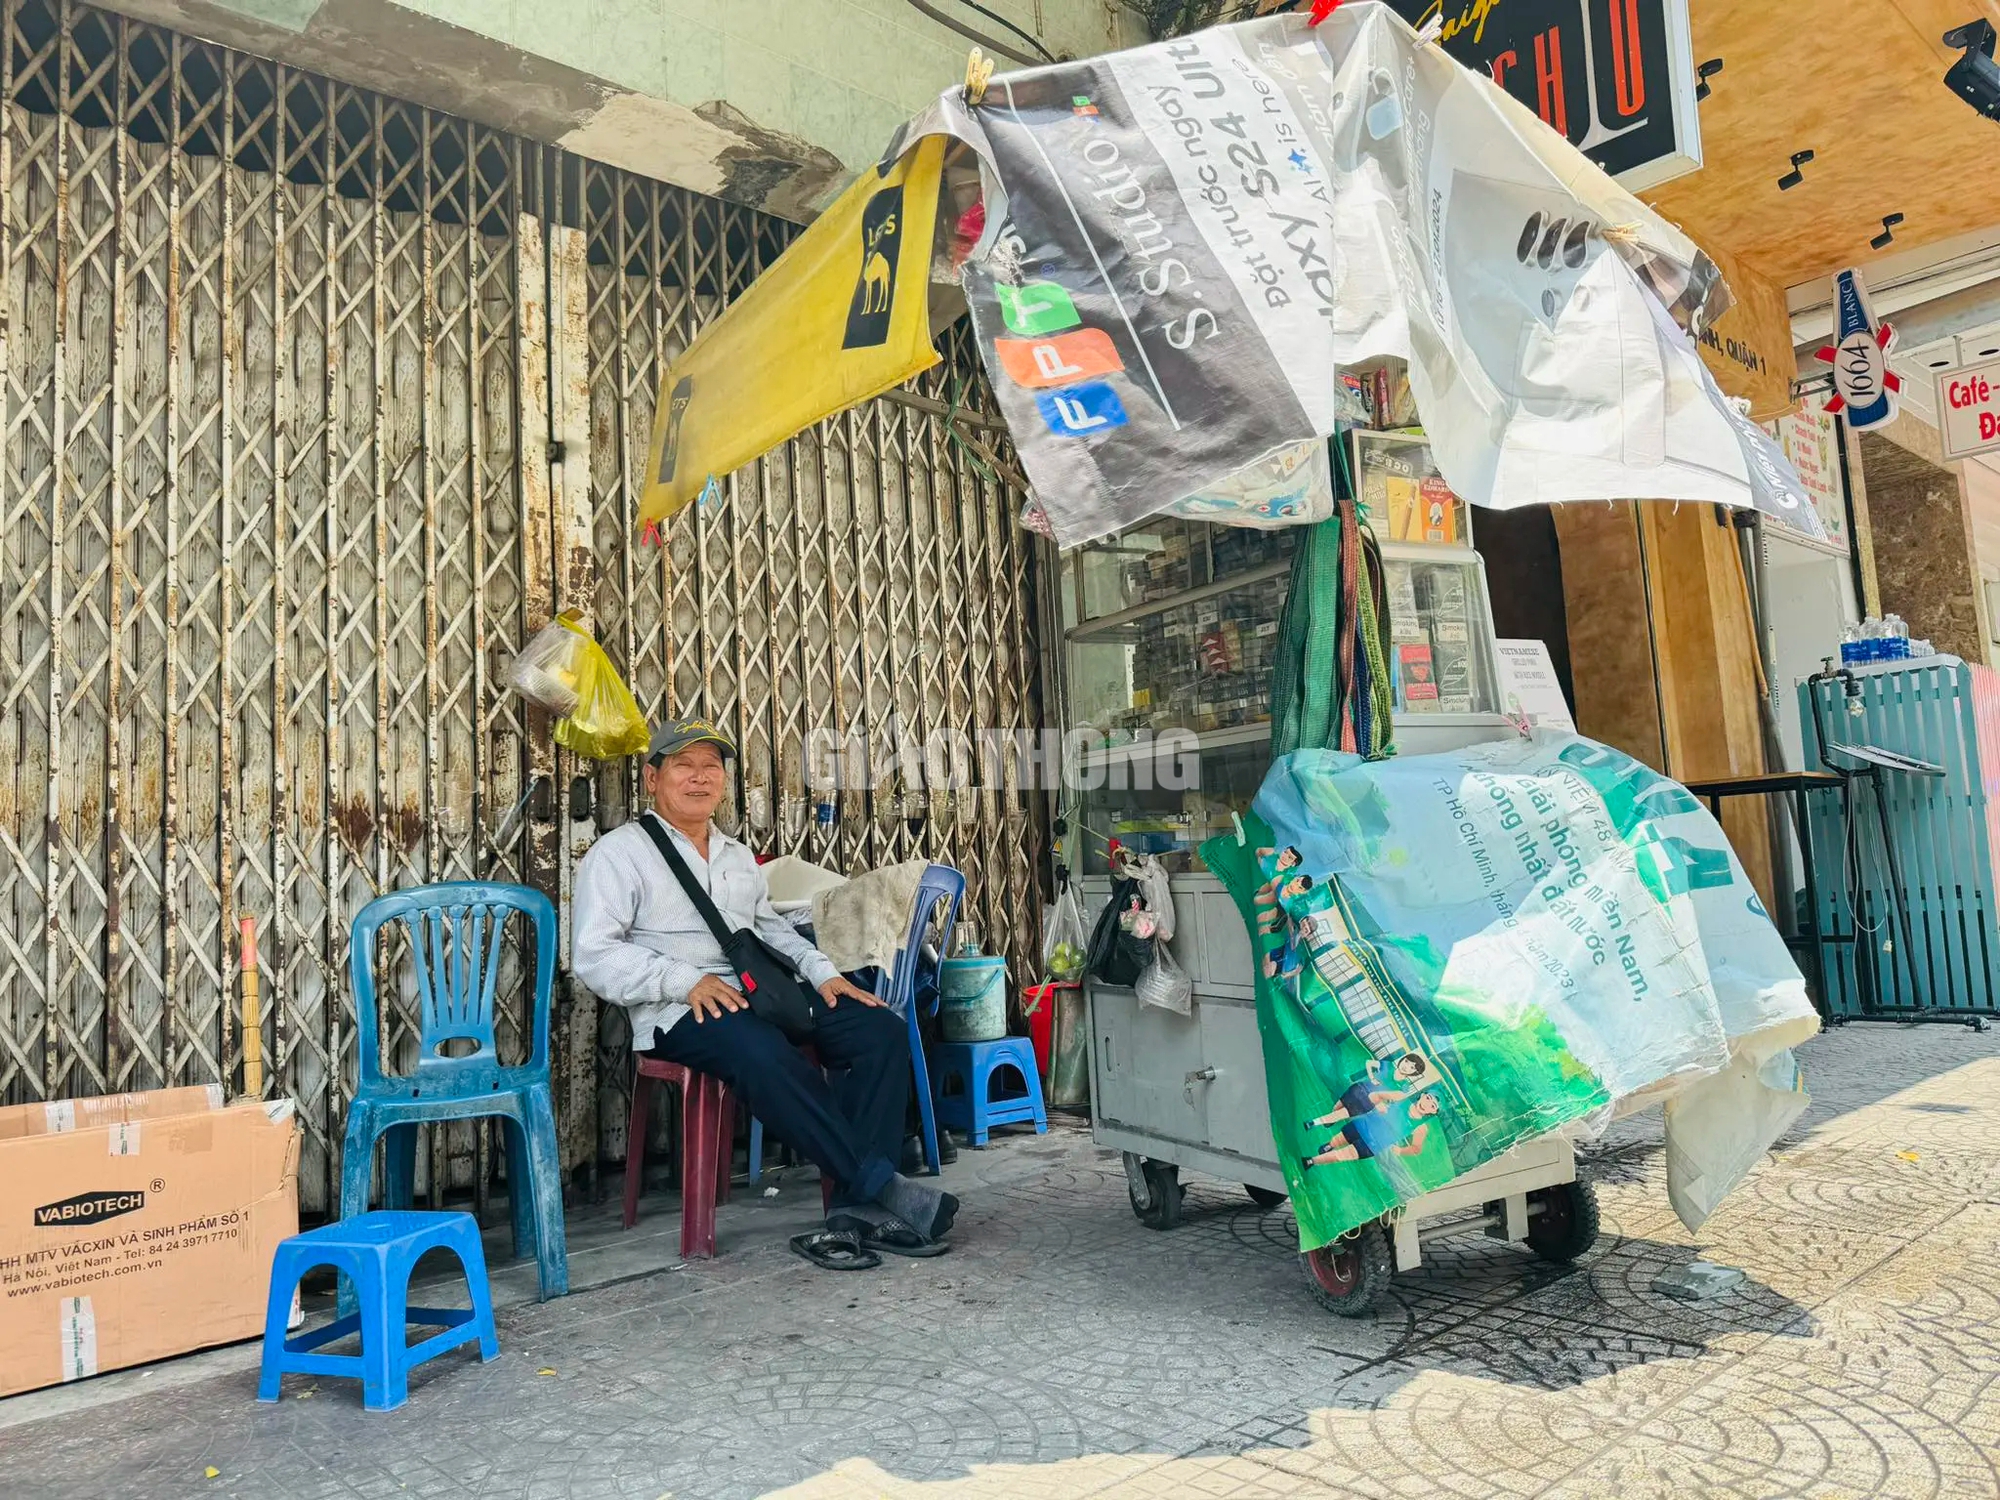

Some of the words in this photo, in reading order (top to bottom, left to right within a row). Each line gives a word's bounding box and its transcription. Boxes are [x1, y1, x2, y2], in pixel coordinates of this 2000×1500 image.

[1165, 35, 1226, 99] Ult
[1231, 57, 1282, 114] here
[1147, 84, 1208, 158] ngay
[1274, 122, 1298, 145] is
[1209, 111, 1280, 198] S24
[1198, 164, 1254, 249] trước
[1242, 251, 1292, 309] Đặt
[1841, 282, 1860, 328] BLANC
[1726, 337, 1759, 373] QUẬN
[1760, 355, 1767, 375] 1
[1841, 338, 1876, 398] 1664
[1949, 374, 1990, 409] Café
[1979, 411, 2000, 440] Đ
[1499, 647, 1540, 656] VIETNAMESE
[1593, 819, 1613, 842] 48
[1432, 777, 1454, 796] TP
[1446, 798, 1467, 820] Hồ
[1459, 822, 1485, 847] Chí
[1472, 848, 1498, 888] Minh,
[1490, 889, 1519, 929] tháng
[1543, 957, 1575, 989] 2023
[1514, 831, 1553, 882] nhất
[1541, 885, 1578, 919] đất
[1568, 916, 1606, 966] nước
[1516, 777, 1557, 815] Giải
[1540, 818, 1588, 889] phóng
[1584, 884, 1622, 929] miền
[1615, 934, 1649, 1002] Nam,
[26, 1250, 57, 1264] MTV
[119, 1229, 139, 1246] VÀ
[143, 1226, 175, 1242] SINH
[221, 1207, 239, 1226] SỐ
[243, 1211, 249, 1222] 1
[38, 1194, 143, 1224] VABIOTECH
[7, 1259, 163, 1299] www.vabiotech.com.vn
[56, 1260, 80, 1276] Việt
[84, 1256, 112, 1270] Nam
[124, 1248, 146, 1261] Tel:
[149, 1243, 163, 1255] 84
[166, 1240, 180, 1252] 24
[182, 1235, 209, 1249] 3971
[211, 1228, 239, 1244] 7710
